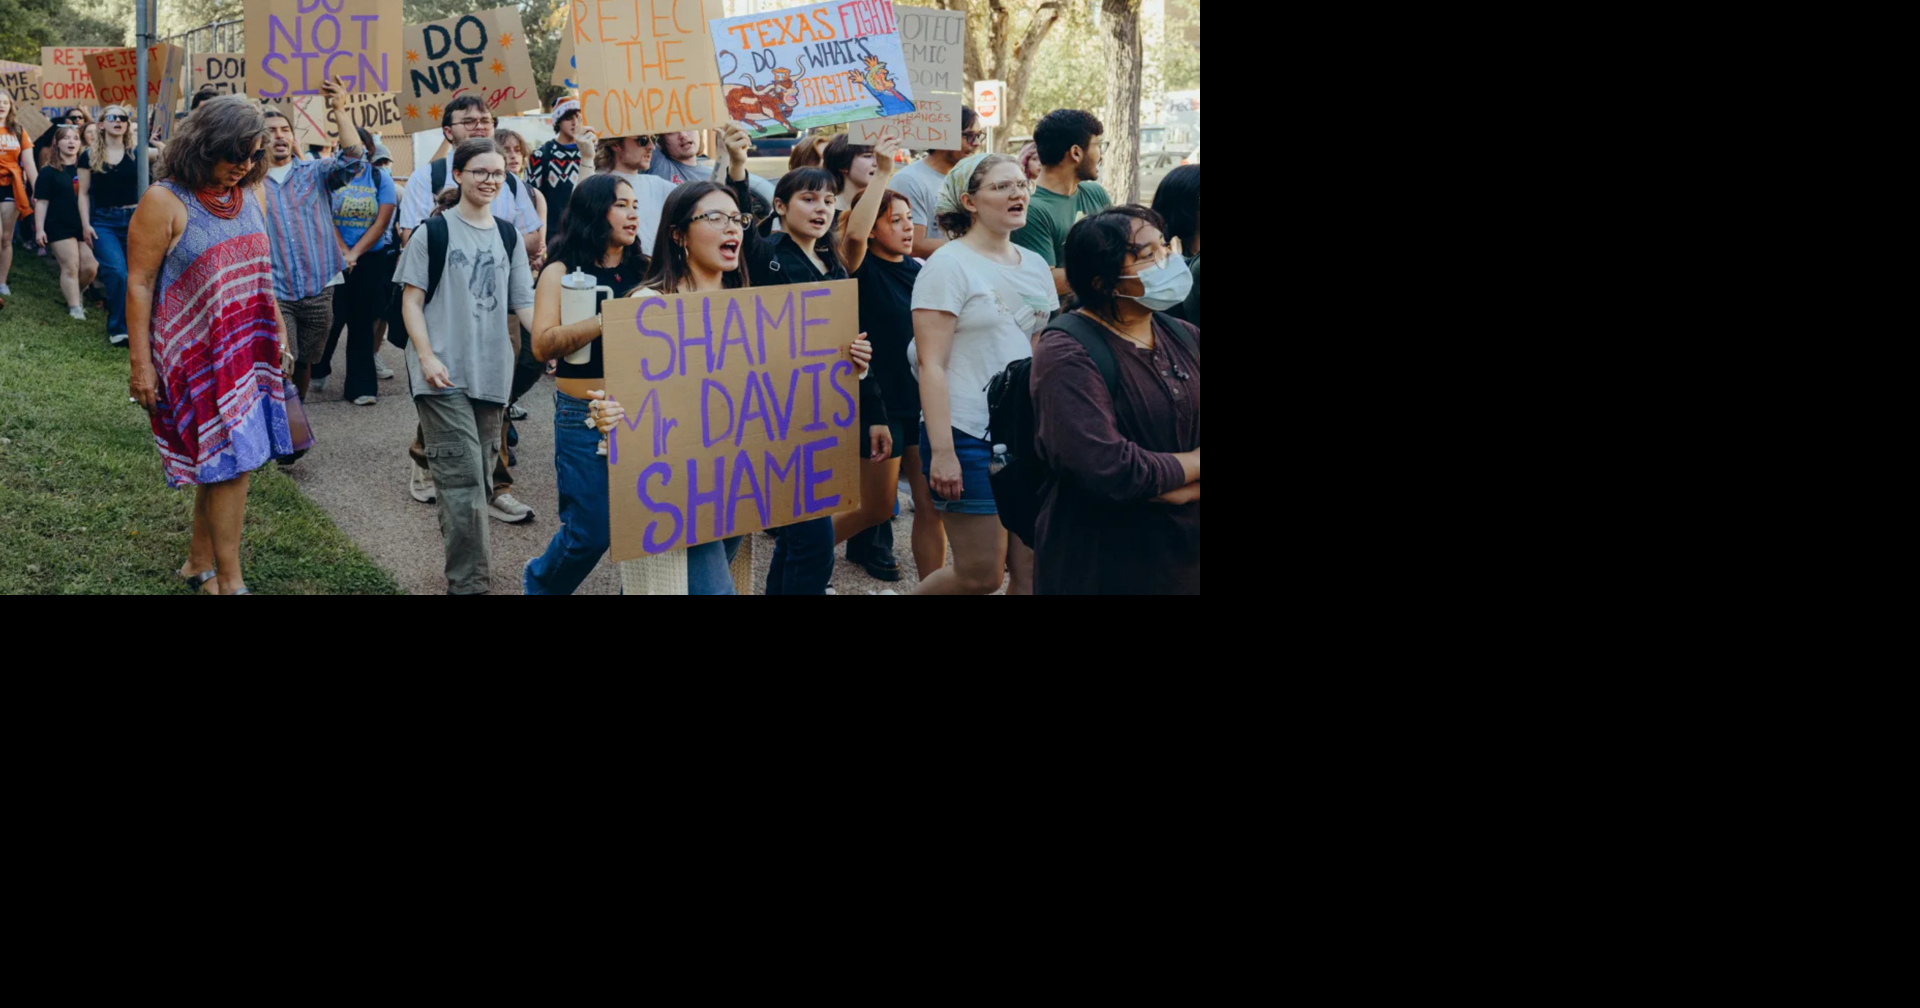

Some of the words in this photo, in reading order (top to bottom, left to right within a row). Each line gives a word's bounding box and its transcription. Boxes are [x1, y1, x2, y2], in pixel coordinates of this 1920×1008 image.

[268, 13, 380, 54] NOT
[422, 15, 488, 60] DO
[572, 0, 706, 45] REJECT
[728, 7, 837, 50] TEXAS
[838, 0, 897, 39] FIGHT!
[67, 68, 91, 82] TH
[96, 47, 158, 71] REJET
[115, 67, 137, 83] TH
[258, 50, 388, 98] SIGN
[615, 41, 686, 83] THE
[752, 48, 776, 74] DO
[803, 37, 873, 69] WHAT'S
[43, 82, 96, 100] COMPA
[410, 56, 483, 98] NOT
[800, 71, 866, 108] RIGHT!
[909, 68, 949, 90] DOM
[326, 96, 401, 138] SUDIES
[580, 82, 720, 138] COMPACT
[860, 123, 948, 146] WORLD!
[635, 288, 839, 382] SHAME
[608, 388, 679, 466] Mr
[699, 359, 857, 449] DAVIS
[636, 435, 842, 555] SHAME
